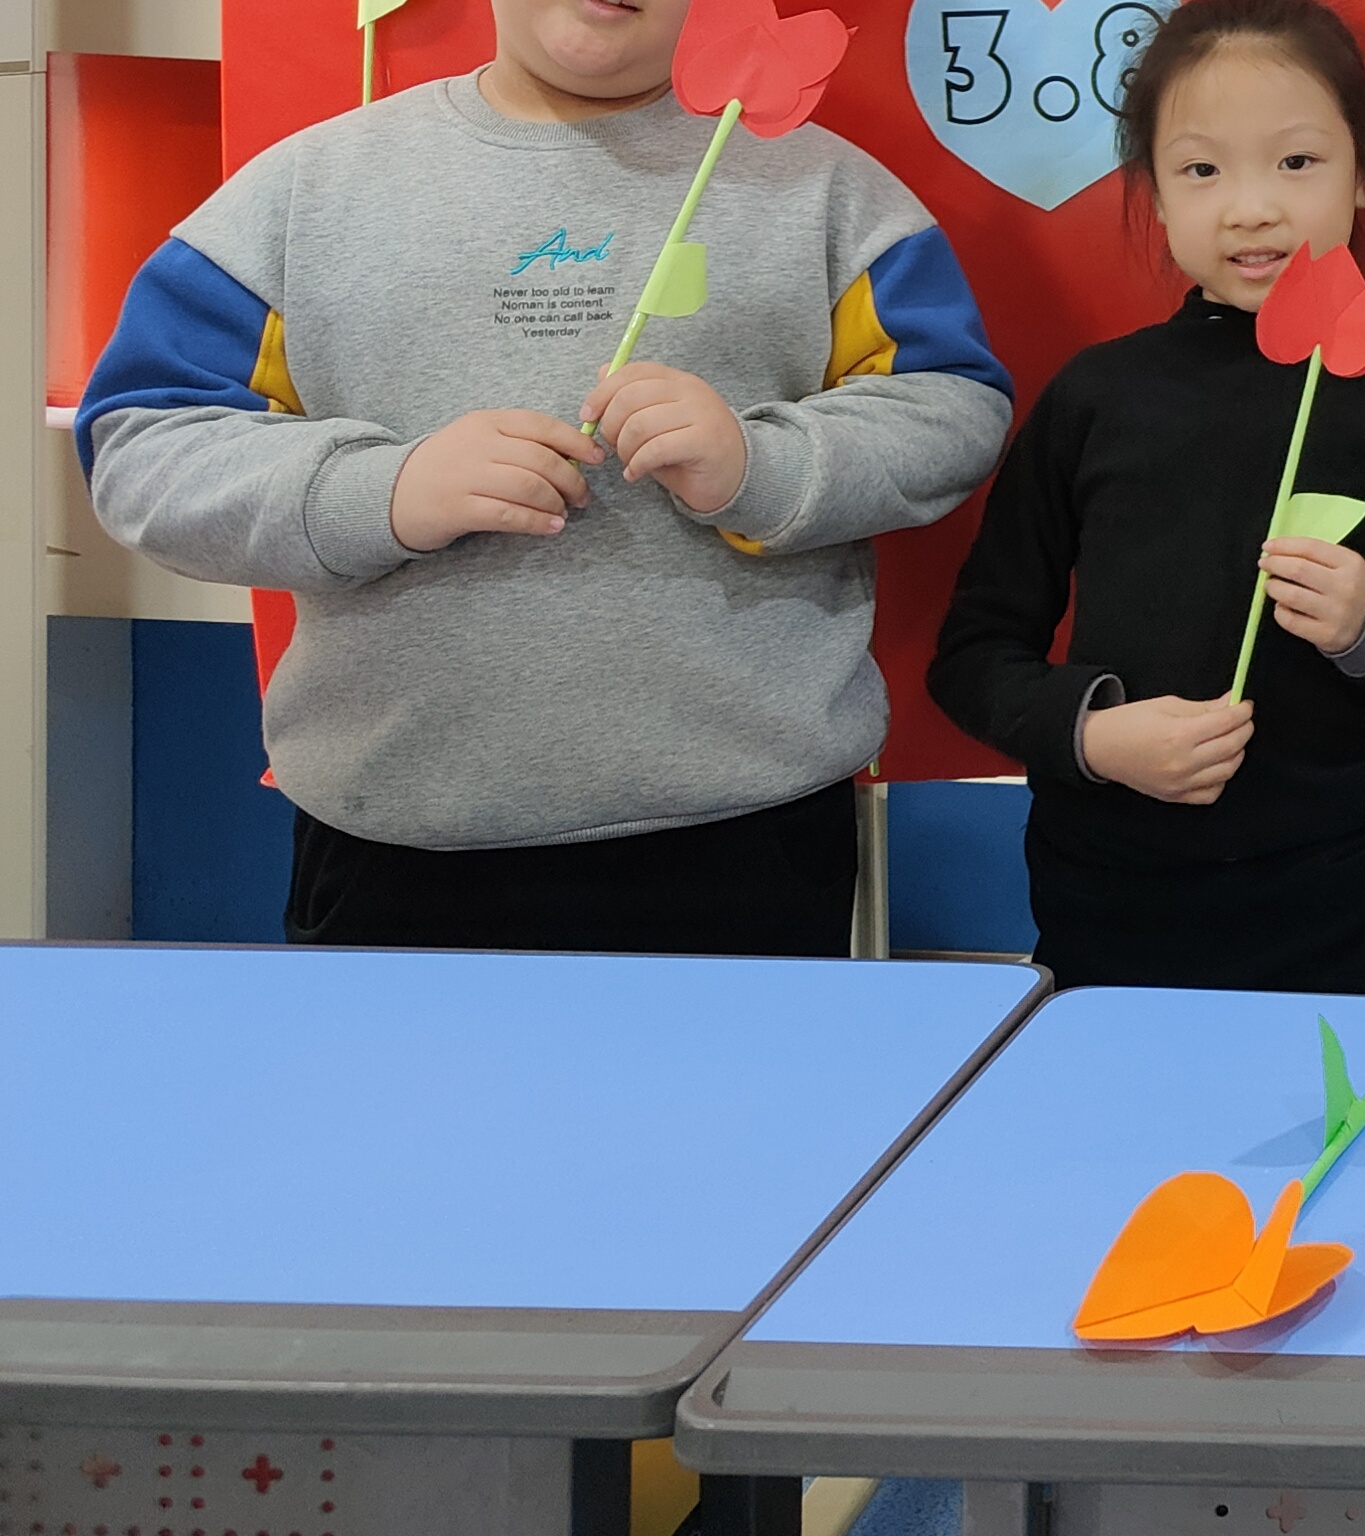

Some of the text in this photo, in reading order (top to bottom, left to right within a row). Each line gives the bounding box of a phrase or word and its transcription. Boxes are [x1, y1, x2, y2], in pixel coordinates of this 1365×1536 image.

[493, 288, 529, 298] Never
[531, 287, 550, 297] too
[552, 286, 571, 296] old
[573, 286, 585, 296] to
[547, 299, 557, 309] is
[560, 298, 604, 309] content
[494, 311, 613, 324] No one can call back
[522, 326, 581, 338] Yesterday
